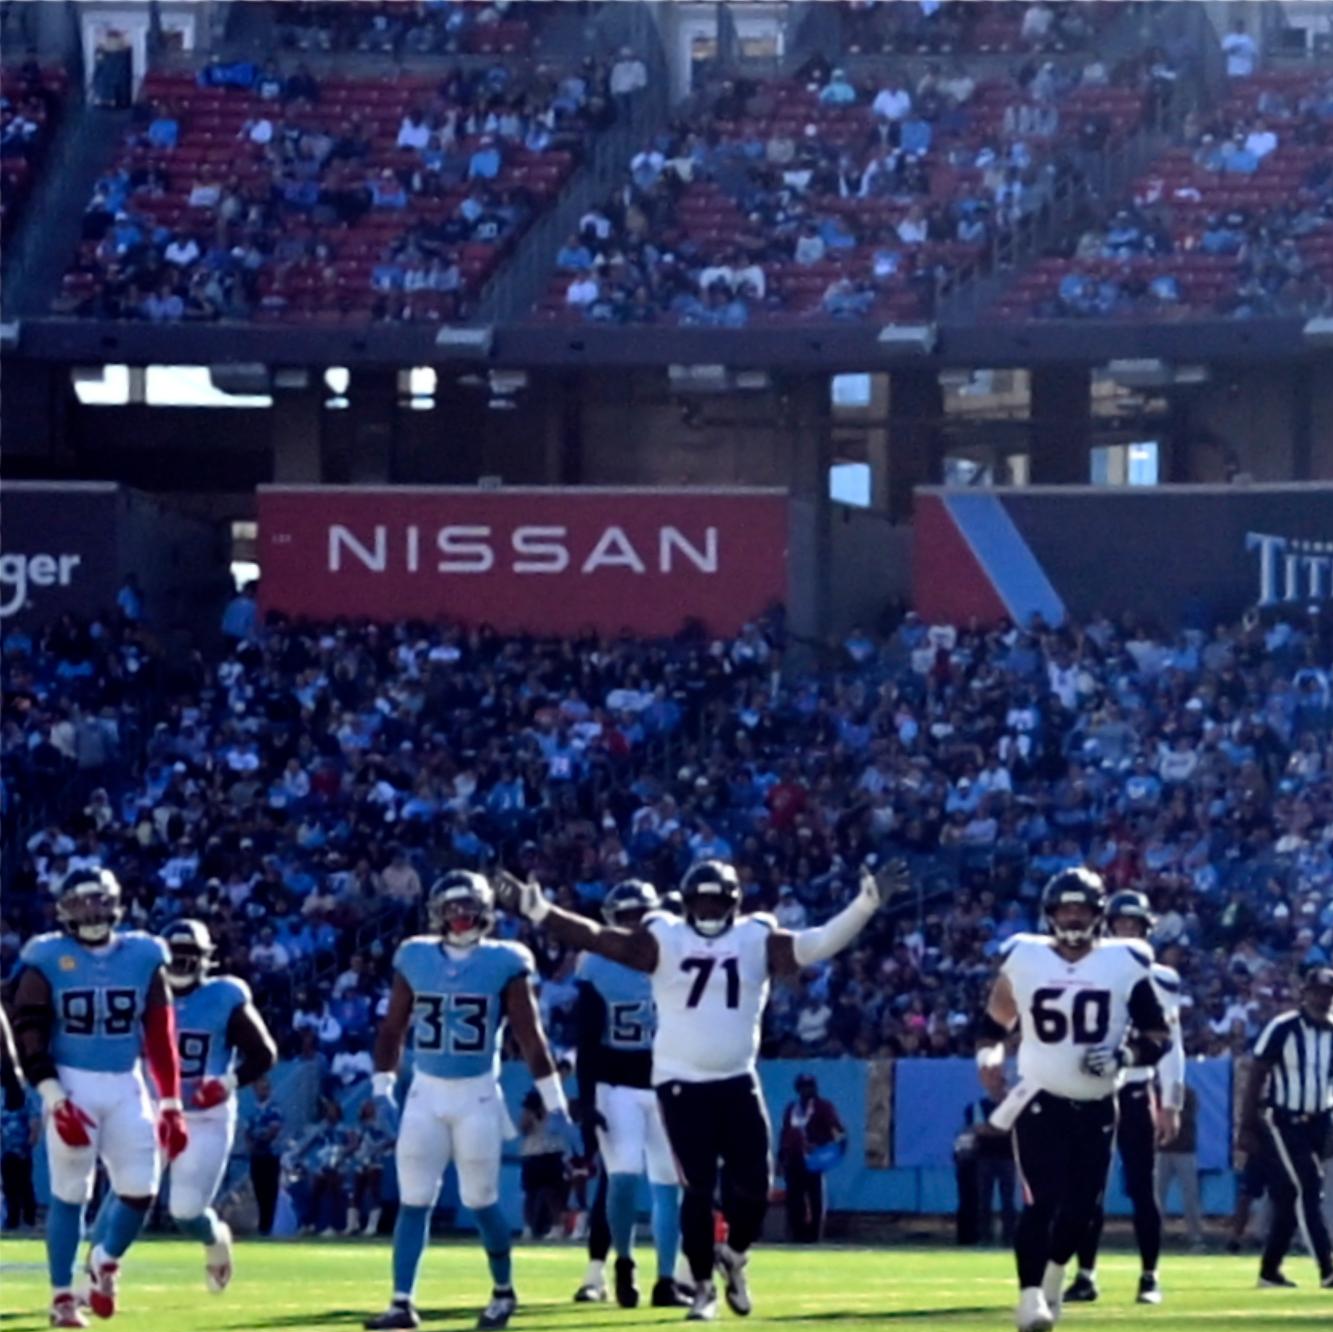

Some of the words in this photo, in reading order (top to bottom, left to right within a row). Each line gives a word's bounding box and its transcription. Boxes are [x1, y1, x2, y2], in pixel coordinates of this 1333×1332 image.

[328, 524, 718, 573] NISSAN
[0, 554, 81, 617] ger
[679, 957, 740, 1009] 71
[59, 988, 139, 1038] 98
[413, 992, 492, 1056] 33
[608, 1001, 658, 1046] 5
[1030, 987, 1111, 1046] 60
